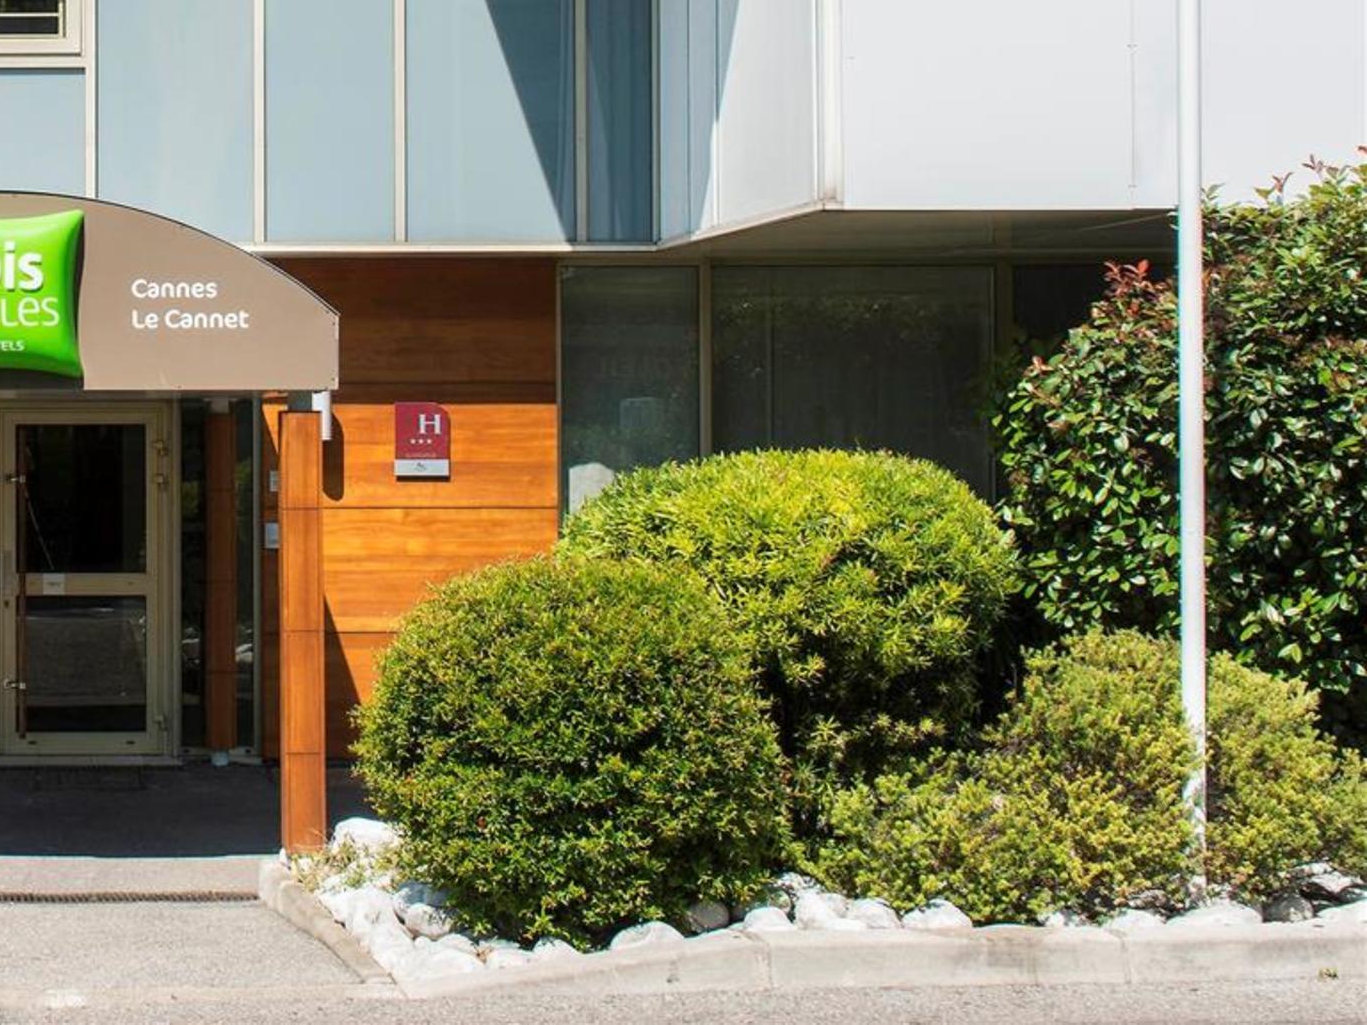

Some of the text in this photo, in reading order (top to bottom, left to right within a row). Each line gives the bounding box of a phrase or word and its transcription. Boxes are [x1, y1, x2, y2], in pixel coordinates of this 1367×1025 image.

[131, 278, 218, 299] Cannes
[131, 309, 249, 329] Le Cannet
[419, 414, 441, 435] H
